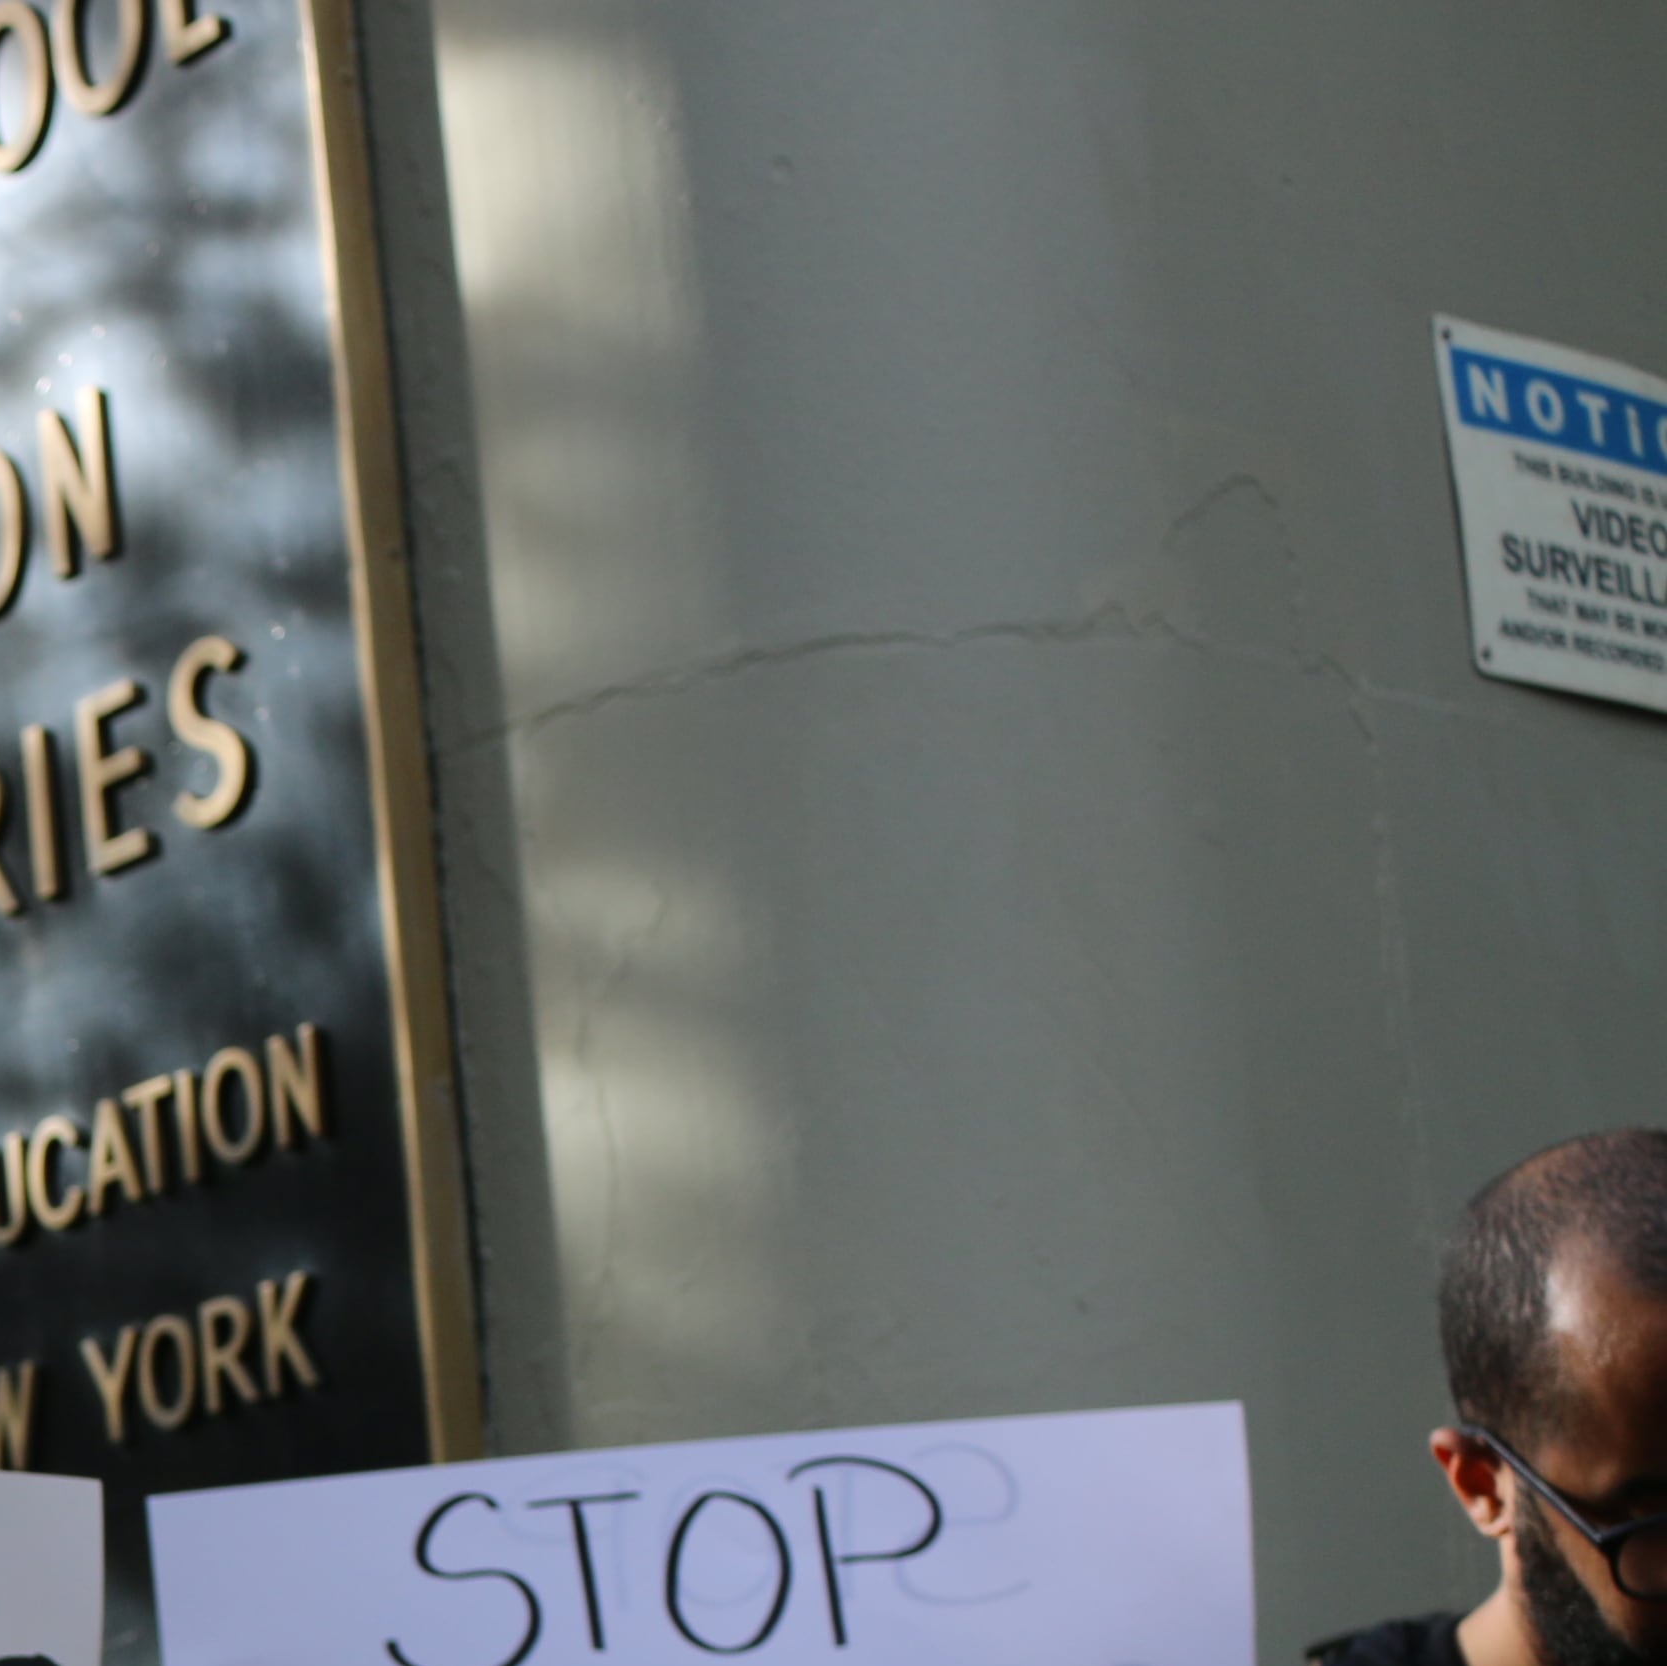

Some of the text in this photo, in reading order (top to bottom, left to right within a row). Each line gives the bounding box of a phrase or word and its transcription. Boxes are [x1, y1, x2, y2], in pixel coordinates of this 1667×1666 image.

[1468, 363, 1667, 462] NOTI
[1500, 531, 1667, 608] SURVEILL
[1571, 497, 1667, 560] VIDEO
[82, 1269, 320, 1445] YORK
